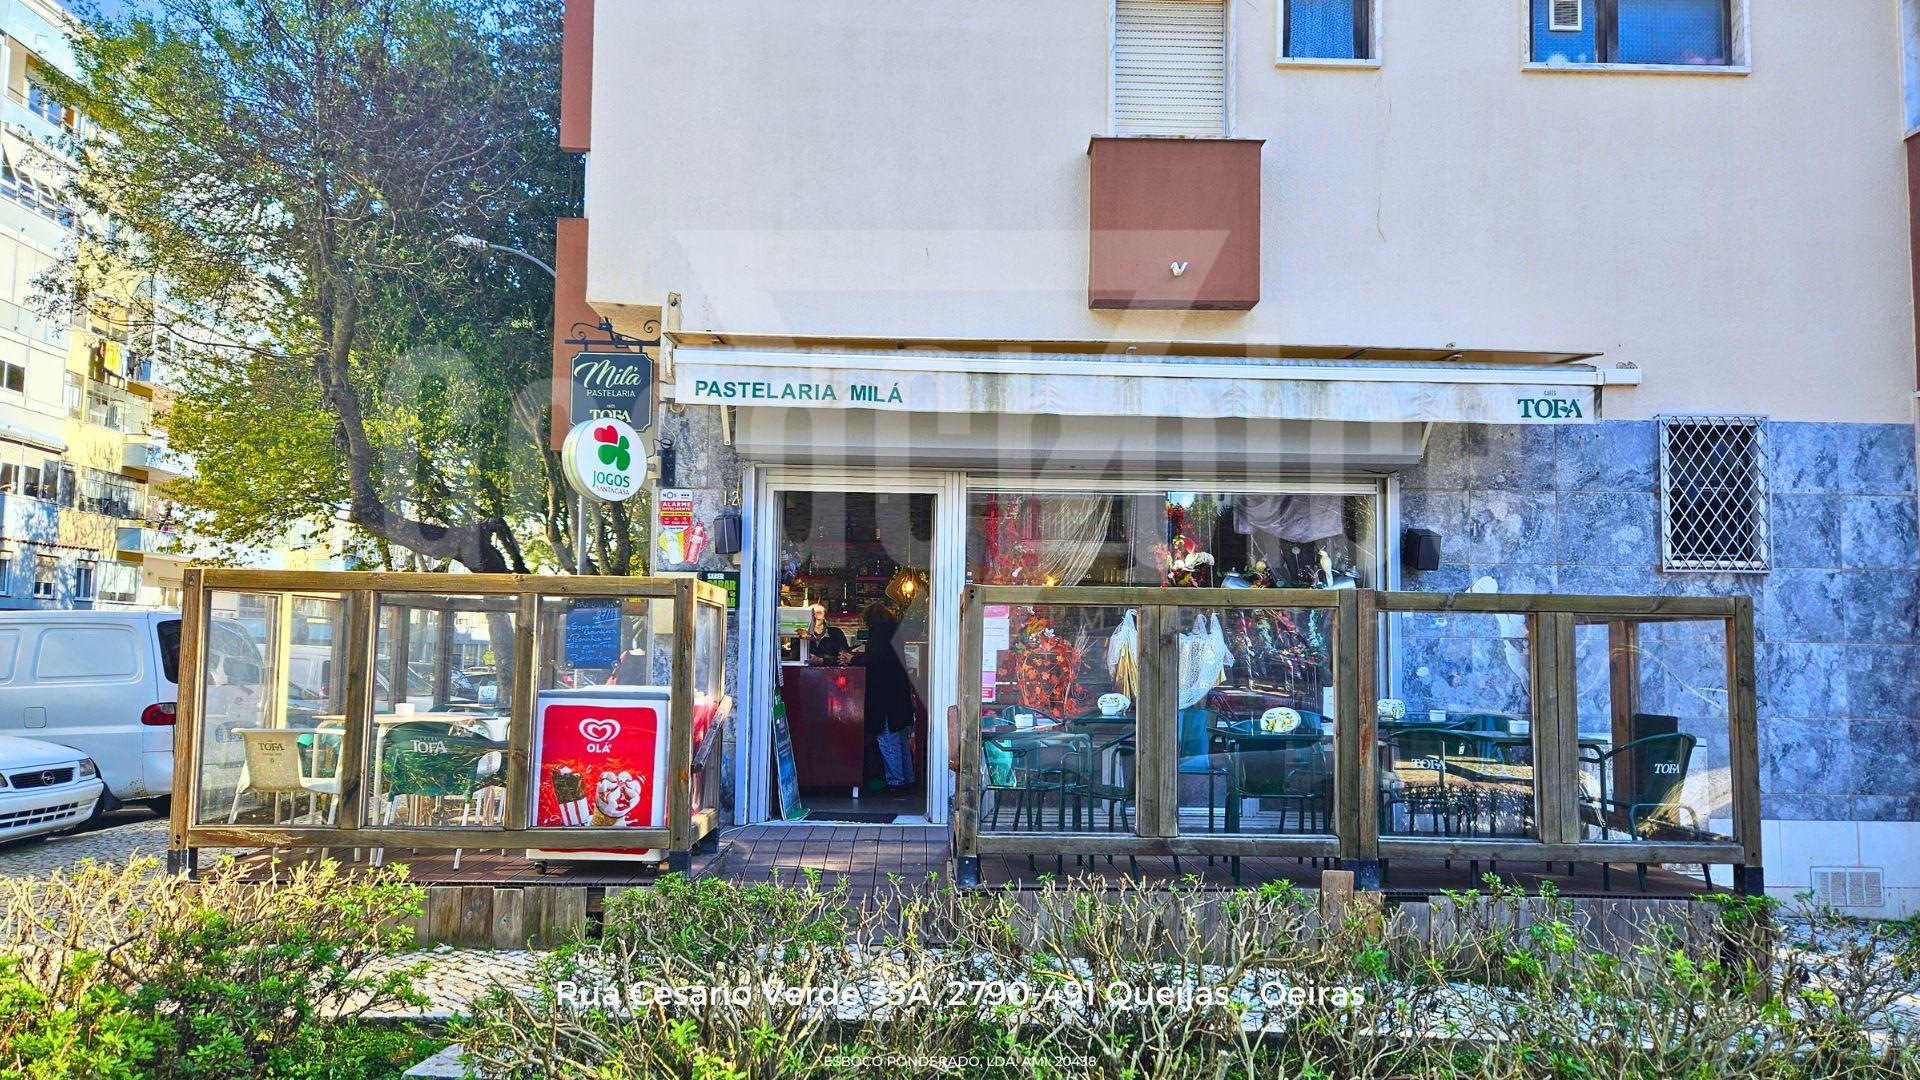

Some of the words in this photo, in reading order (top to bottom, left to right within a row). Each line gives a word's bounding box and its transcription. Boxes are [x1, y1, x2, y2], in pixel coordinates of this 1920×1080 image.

[573, 359, 642, 389] Milá
[586, 389, 636, 397] PASTELARIA
[695, 380, 837, 401] PASTELARIA
[850, 382, 903, 403] MILÁ
[1517, 398, 1583, 418] TOFA
[592, 470, 630, 488] JOGOS
[258, 742, 285, 751] TOFA
[410, 739, 448, 754] TOFA
[586, 741, 611, 753] OLÁ
[1411, 758, 1447, 770] TOFA
[1654, 763, 1680, 774] TOFA
